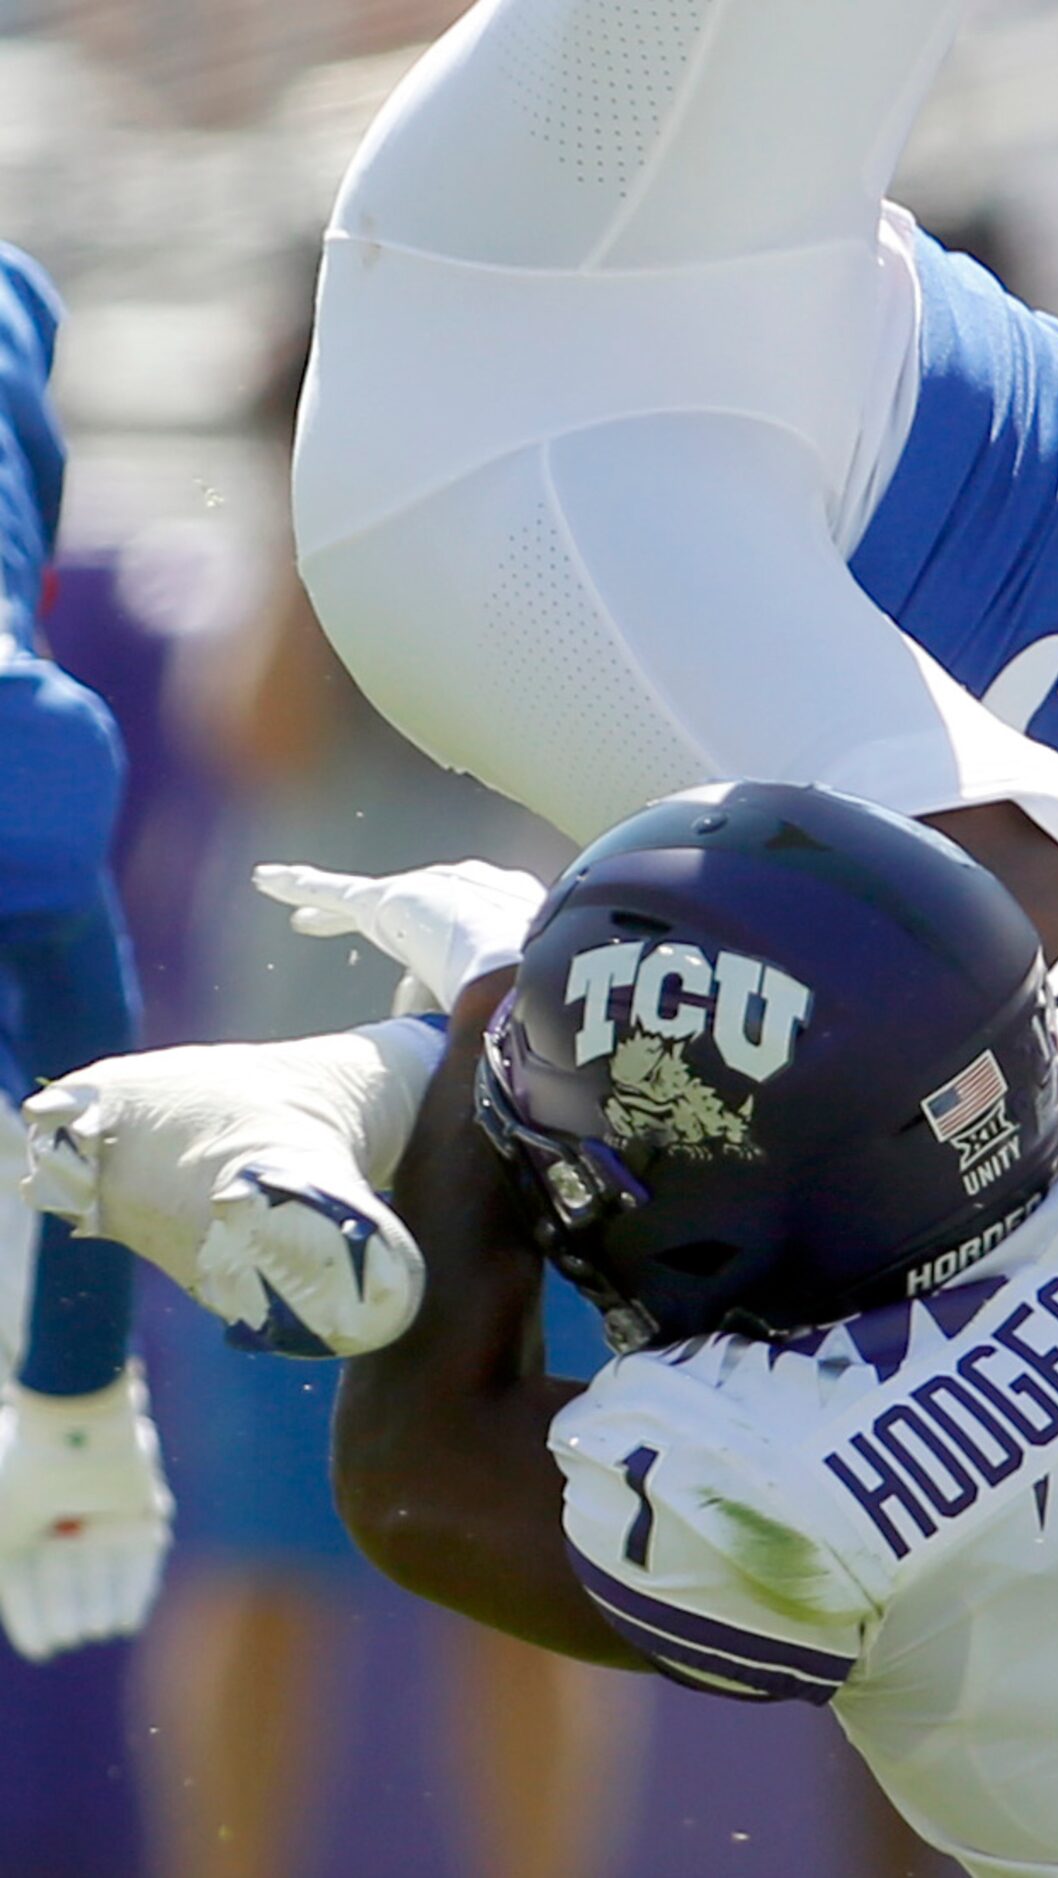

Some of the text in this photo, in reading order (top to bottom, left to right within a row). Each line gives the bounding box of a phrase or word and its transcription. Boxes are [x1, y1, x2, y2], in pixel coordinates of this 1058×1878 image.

[564, 941, 812, 1084] TCU
[963, 1135, 1022, 1196] UNITY
[617, 1440, 662, 1571] 1
